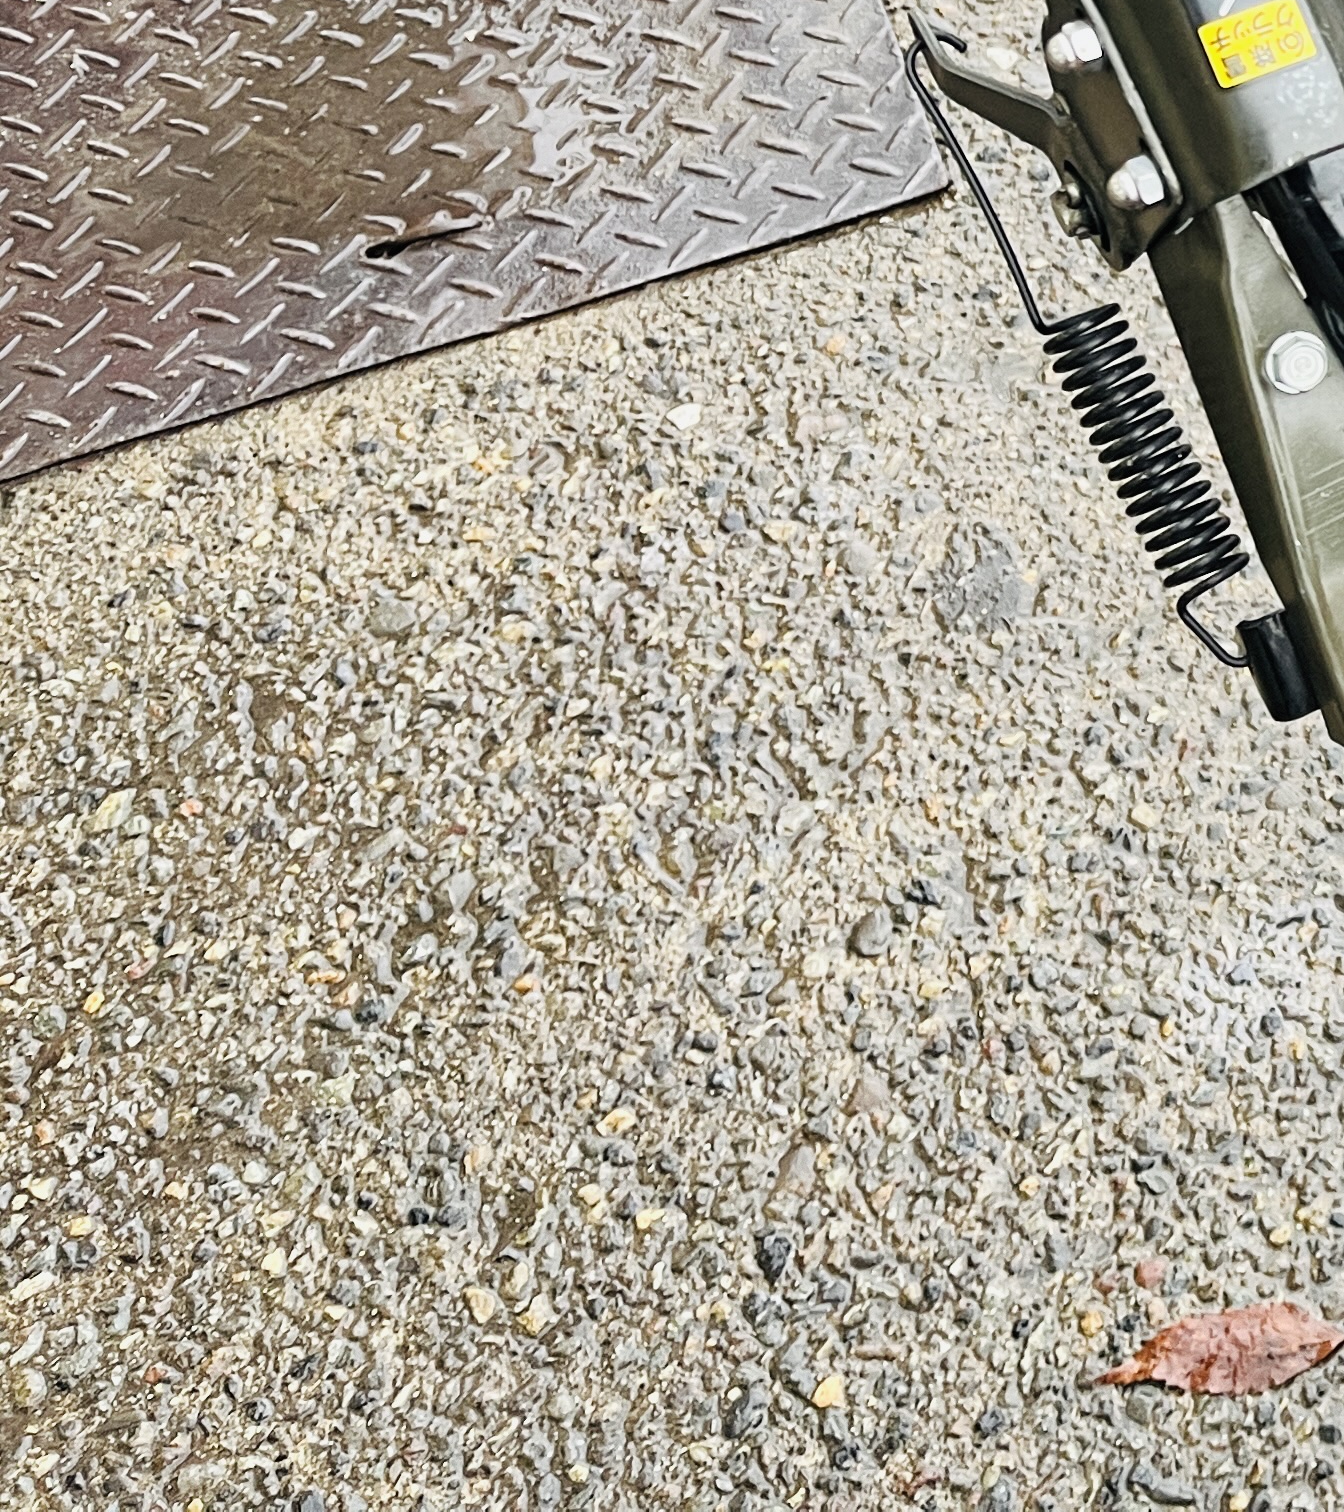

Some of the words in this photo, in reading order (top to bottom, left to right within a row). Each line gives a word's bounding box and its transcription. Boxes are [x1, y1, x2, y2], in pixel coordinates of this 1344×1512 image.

[1211, 3, 1294, 52] クラッチ
[1222, 40, 1276, 80] 除雪
